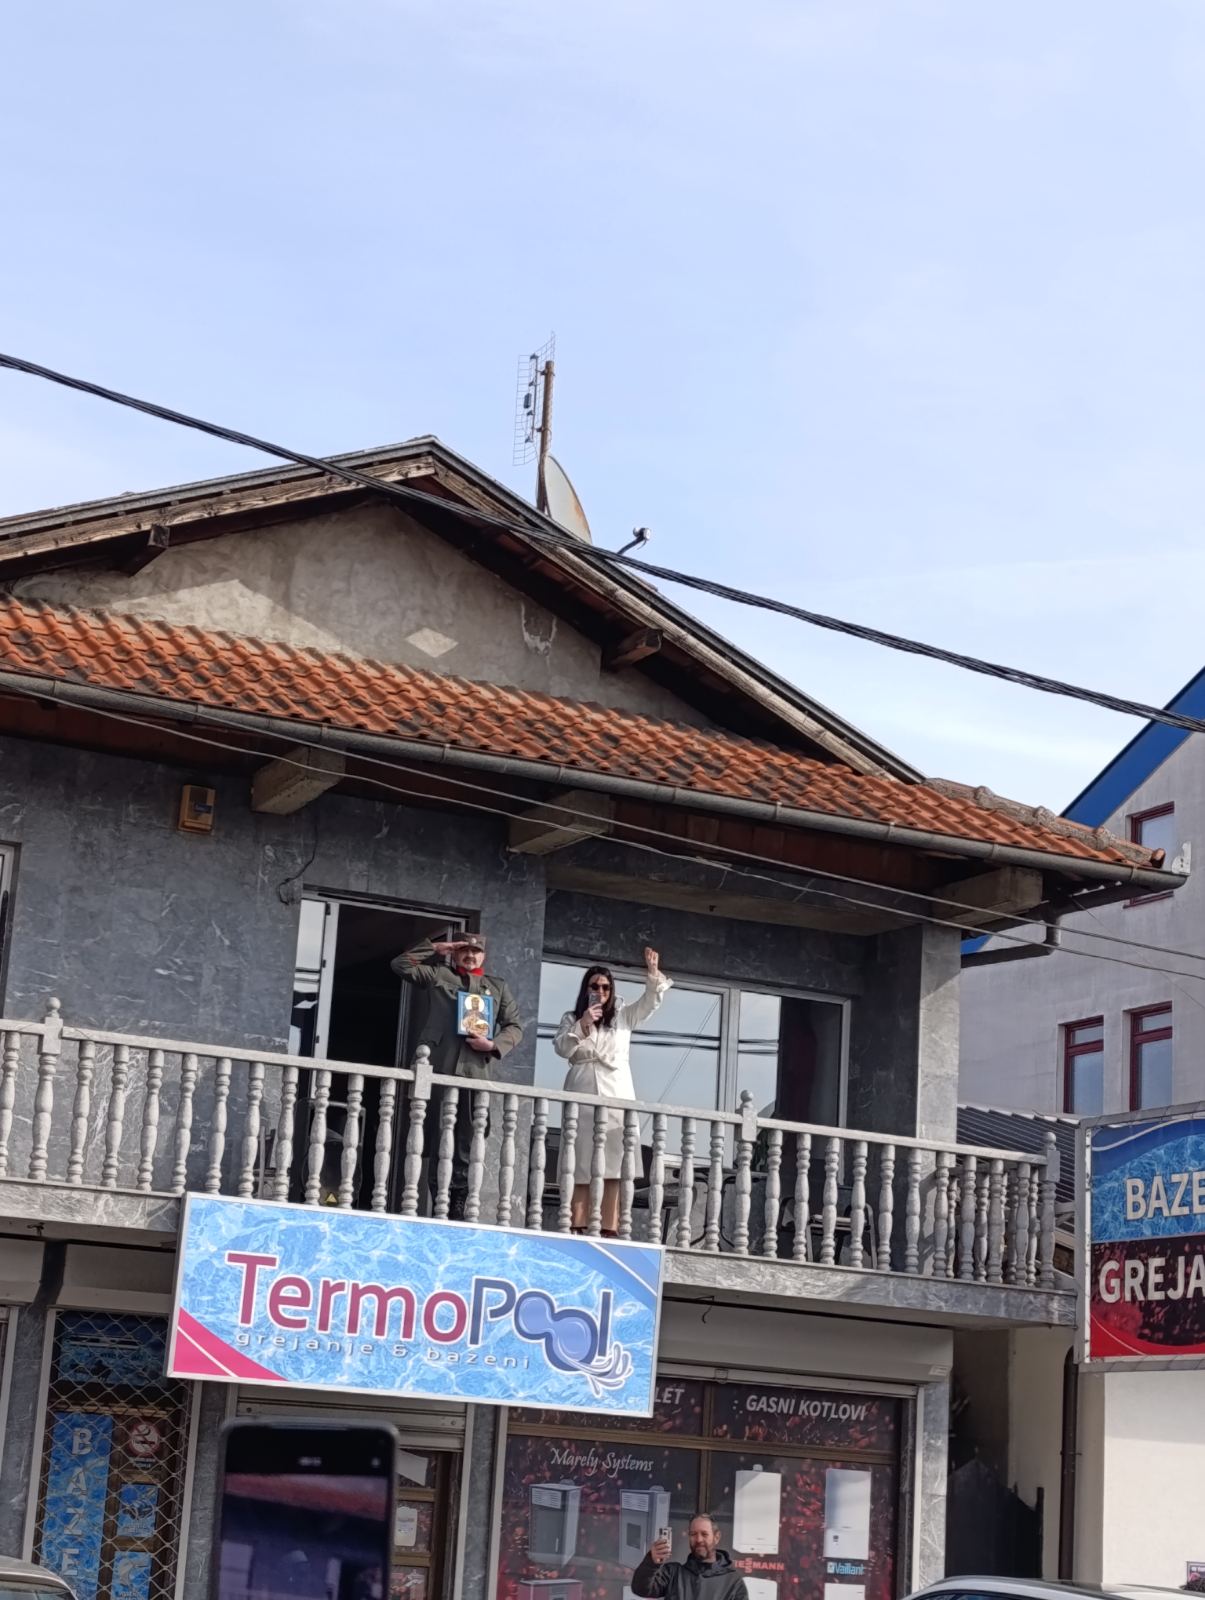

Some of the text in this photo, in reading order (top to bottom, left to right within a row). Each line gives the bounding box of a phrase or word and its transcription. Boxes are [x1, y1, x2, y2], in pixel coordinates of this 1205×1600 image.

[1126, 1171, 1205, 1221] BAZE
[1100, 1254, 1205, 1304] GREJA
[225, 1251, 613, 1373] TermoPool
[235, 1332, 375, 1355] grejanje
[427, 1347, 530, 1371] bazeni
[745, 1395, 867, 1422] GASNI KOTLOVI
[550, 1447, 655, 1479] Marely Systems
